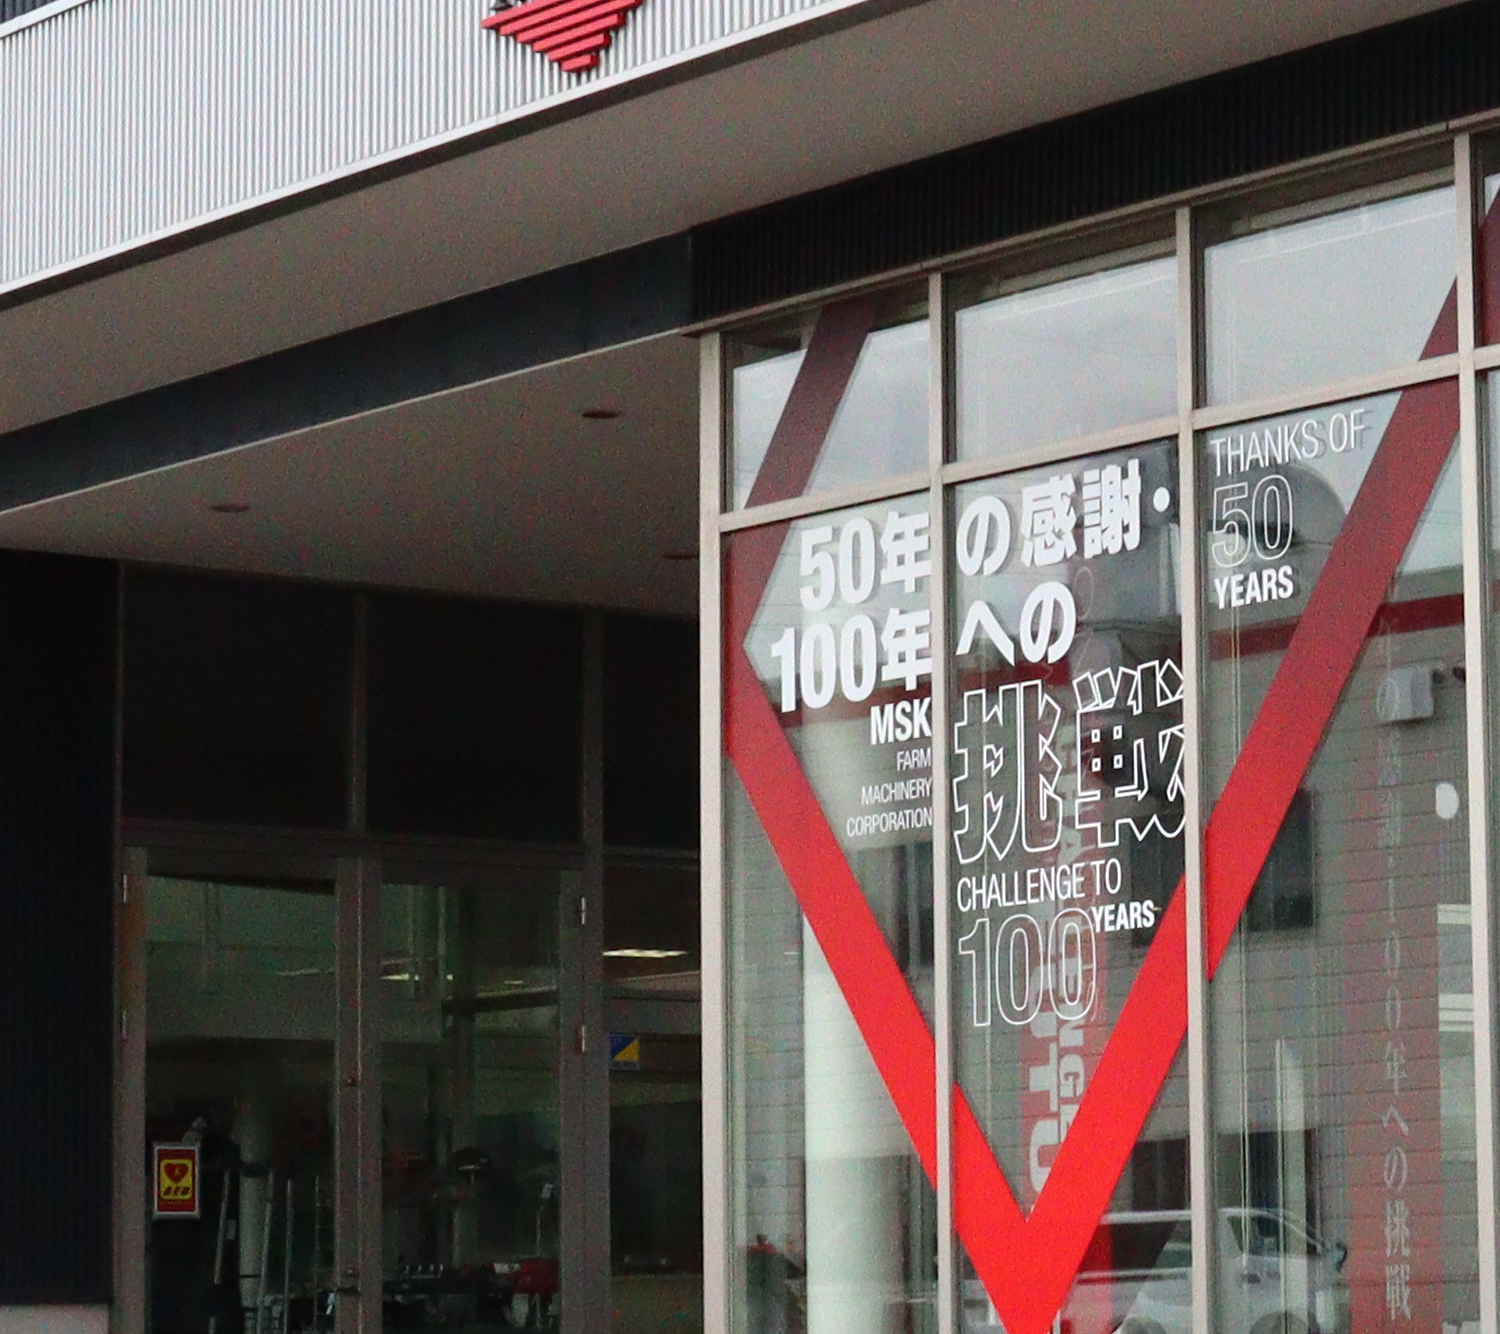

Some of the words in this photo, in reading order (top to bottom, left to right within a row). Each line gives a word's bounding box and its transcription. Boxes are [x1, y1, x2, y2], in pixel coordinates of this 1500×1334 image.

[1210, 418, 1320, 477] THANKS
[1329, 408, 1366, 453] OF
[1211, 473, 1294, 568] 50
[1214, 564, 1295, 610] YEARS
[870, 696, 933, 746] MSK
[896, 747, 931, 772] FARM
[860, 776, 933, 806] MACHINERY
[846, 806, 933, 837] CORPORATION
[957, 864, 1086, 913] CHALLENGE
[1090, 858, 1122, 896] TO
[958, 906, 1097, 1028] 100
[1091, 898, 1156, 933] YEARS
